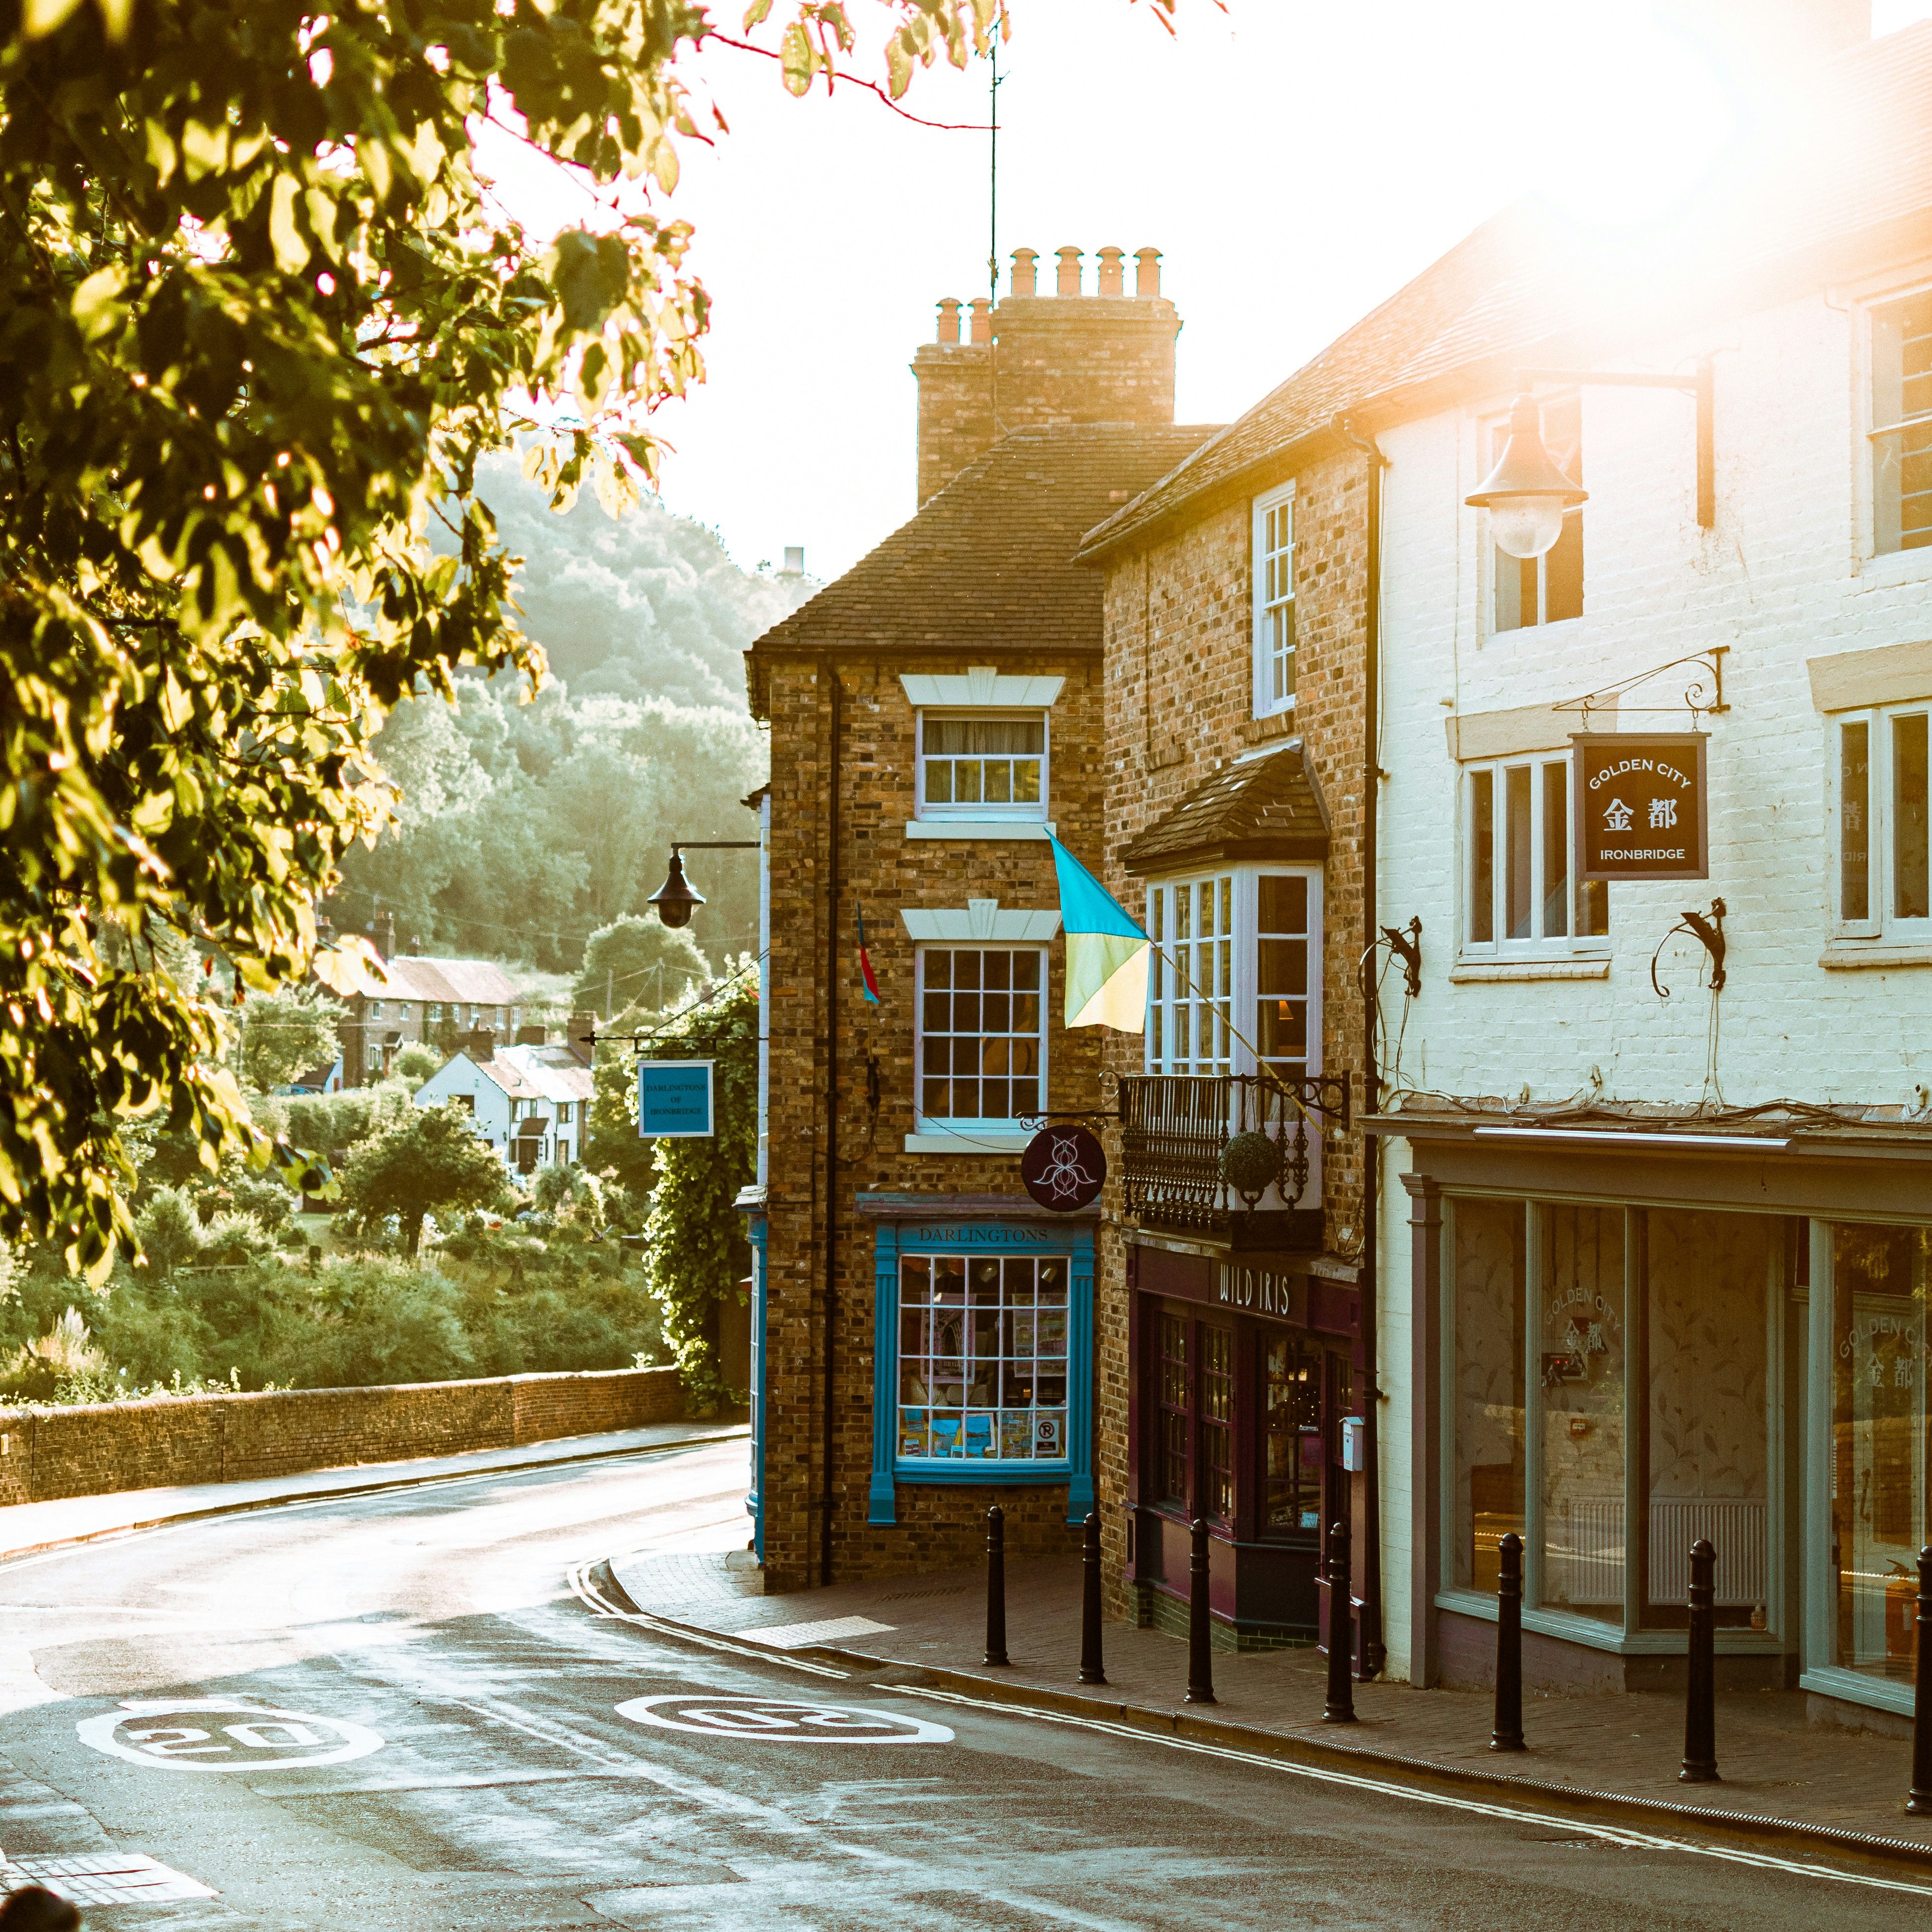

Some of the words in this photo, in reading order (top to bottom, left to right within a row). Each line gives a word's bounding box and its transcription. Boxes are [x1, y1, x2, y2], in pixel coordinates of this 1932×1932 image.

[1589, 758, 1654, 790] GOLDEN
[1657, 763, 1692, 789] CITY
[1602, 798, 1678, 831] 金都
[1600, 849, 1685, 860] IRONBRIDGE
[919, 1228, 1048, 1242] DARLINGTONS
[1220, 1263, 1252, 1306] WILD
[1259, 1271, 1289, 1315] IRIS
[1544, 1287, 1593, 1325] GOLDEN
[1839, 1316, 1901, 1358] GOLDEN
[126, 1723, 325, 1755] 20
